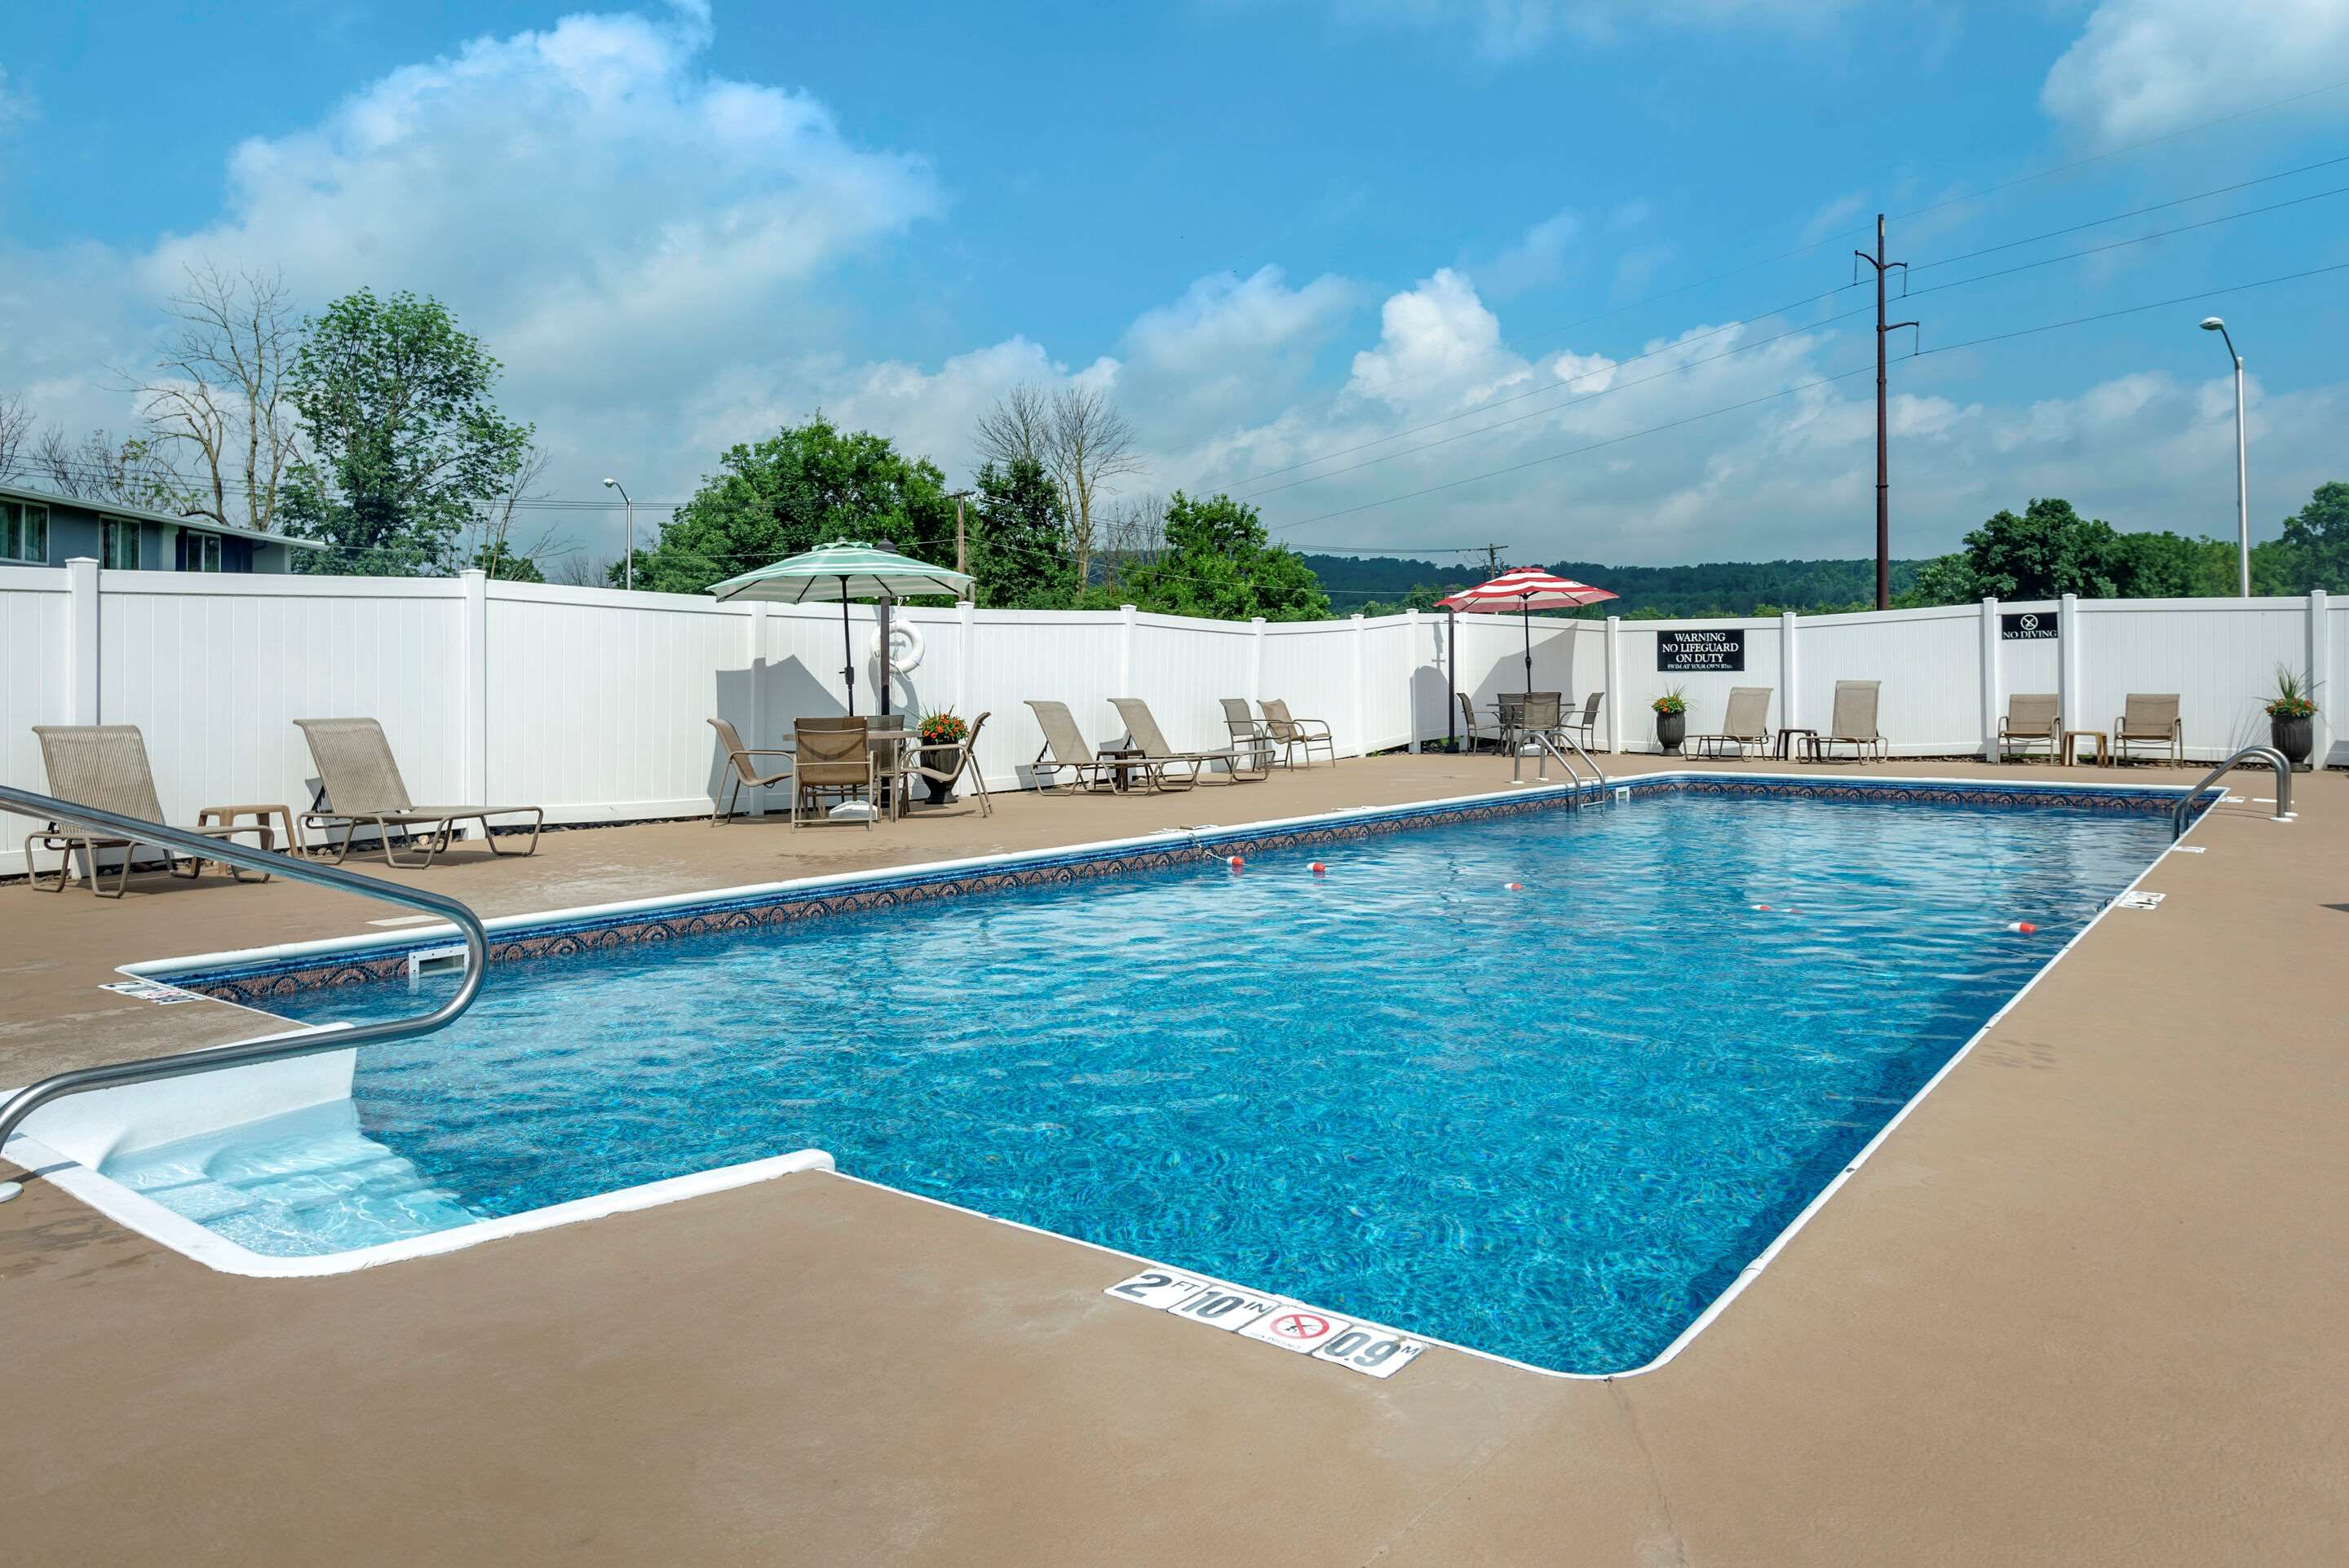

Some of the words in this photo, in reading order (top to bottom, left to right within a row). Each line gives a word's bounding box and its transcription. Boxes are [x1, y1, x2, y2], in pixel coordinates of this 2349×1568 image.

[1674, 633, 1726, 643] WARNING
[2003, 631, 2019, 639] NO
[2020, 630, 2057, 638] DIVING
[1662, 643, 1679, 652] NO
[1680, 643, 1739, 652] LIFEGUARD
[1675, 653, 1692, 663] ON
[1695, 653, 1724, 663] DUTY
[1114, 1274, 1173, 1299] 2
[1170, 1280, 1203, 1292] FT
[1180, 1290, 1245, 1318] 10
[1245, 1302, 1274, 1314] IN
[1324, 1331, 1402, 1367] 0.9
[1400, 1345, 1422, 1357] M
